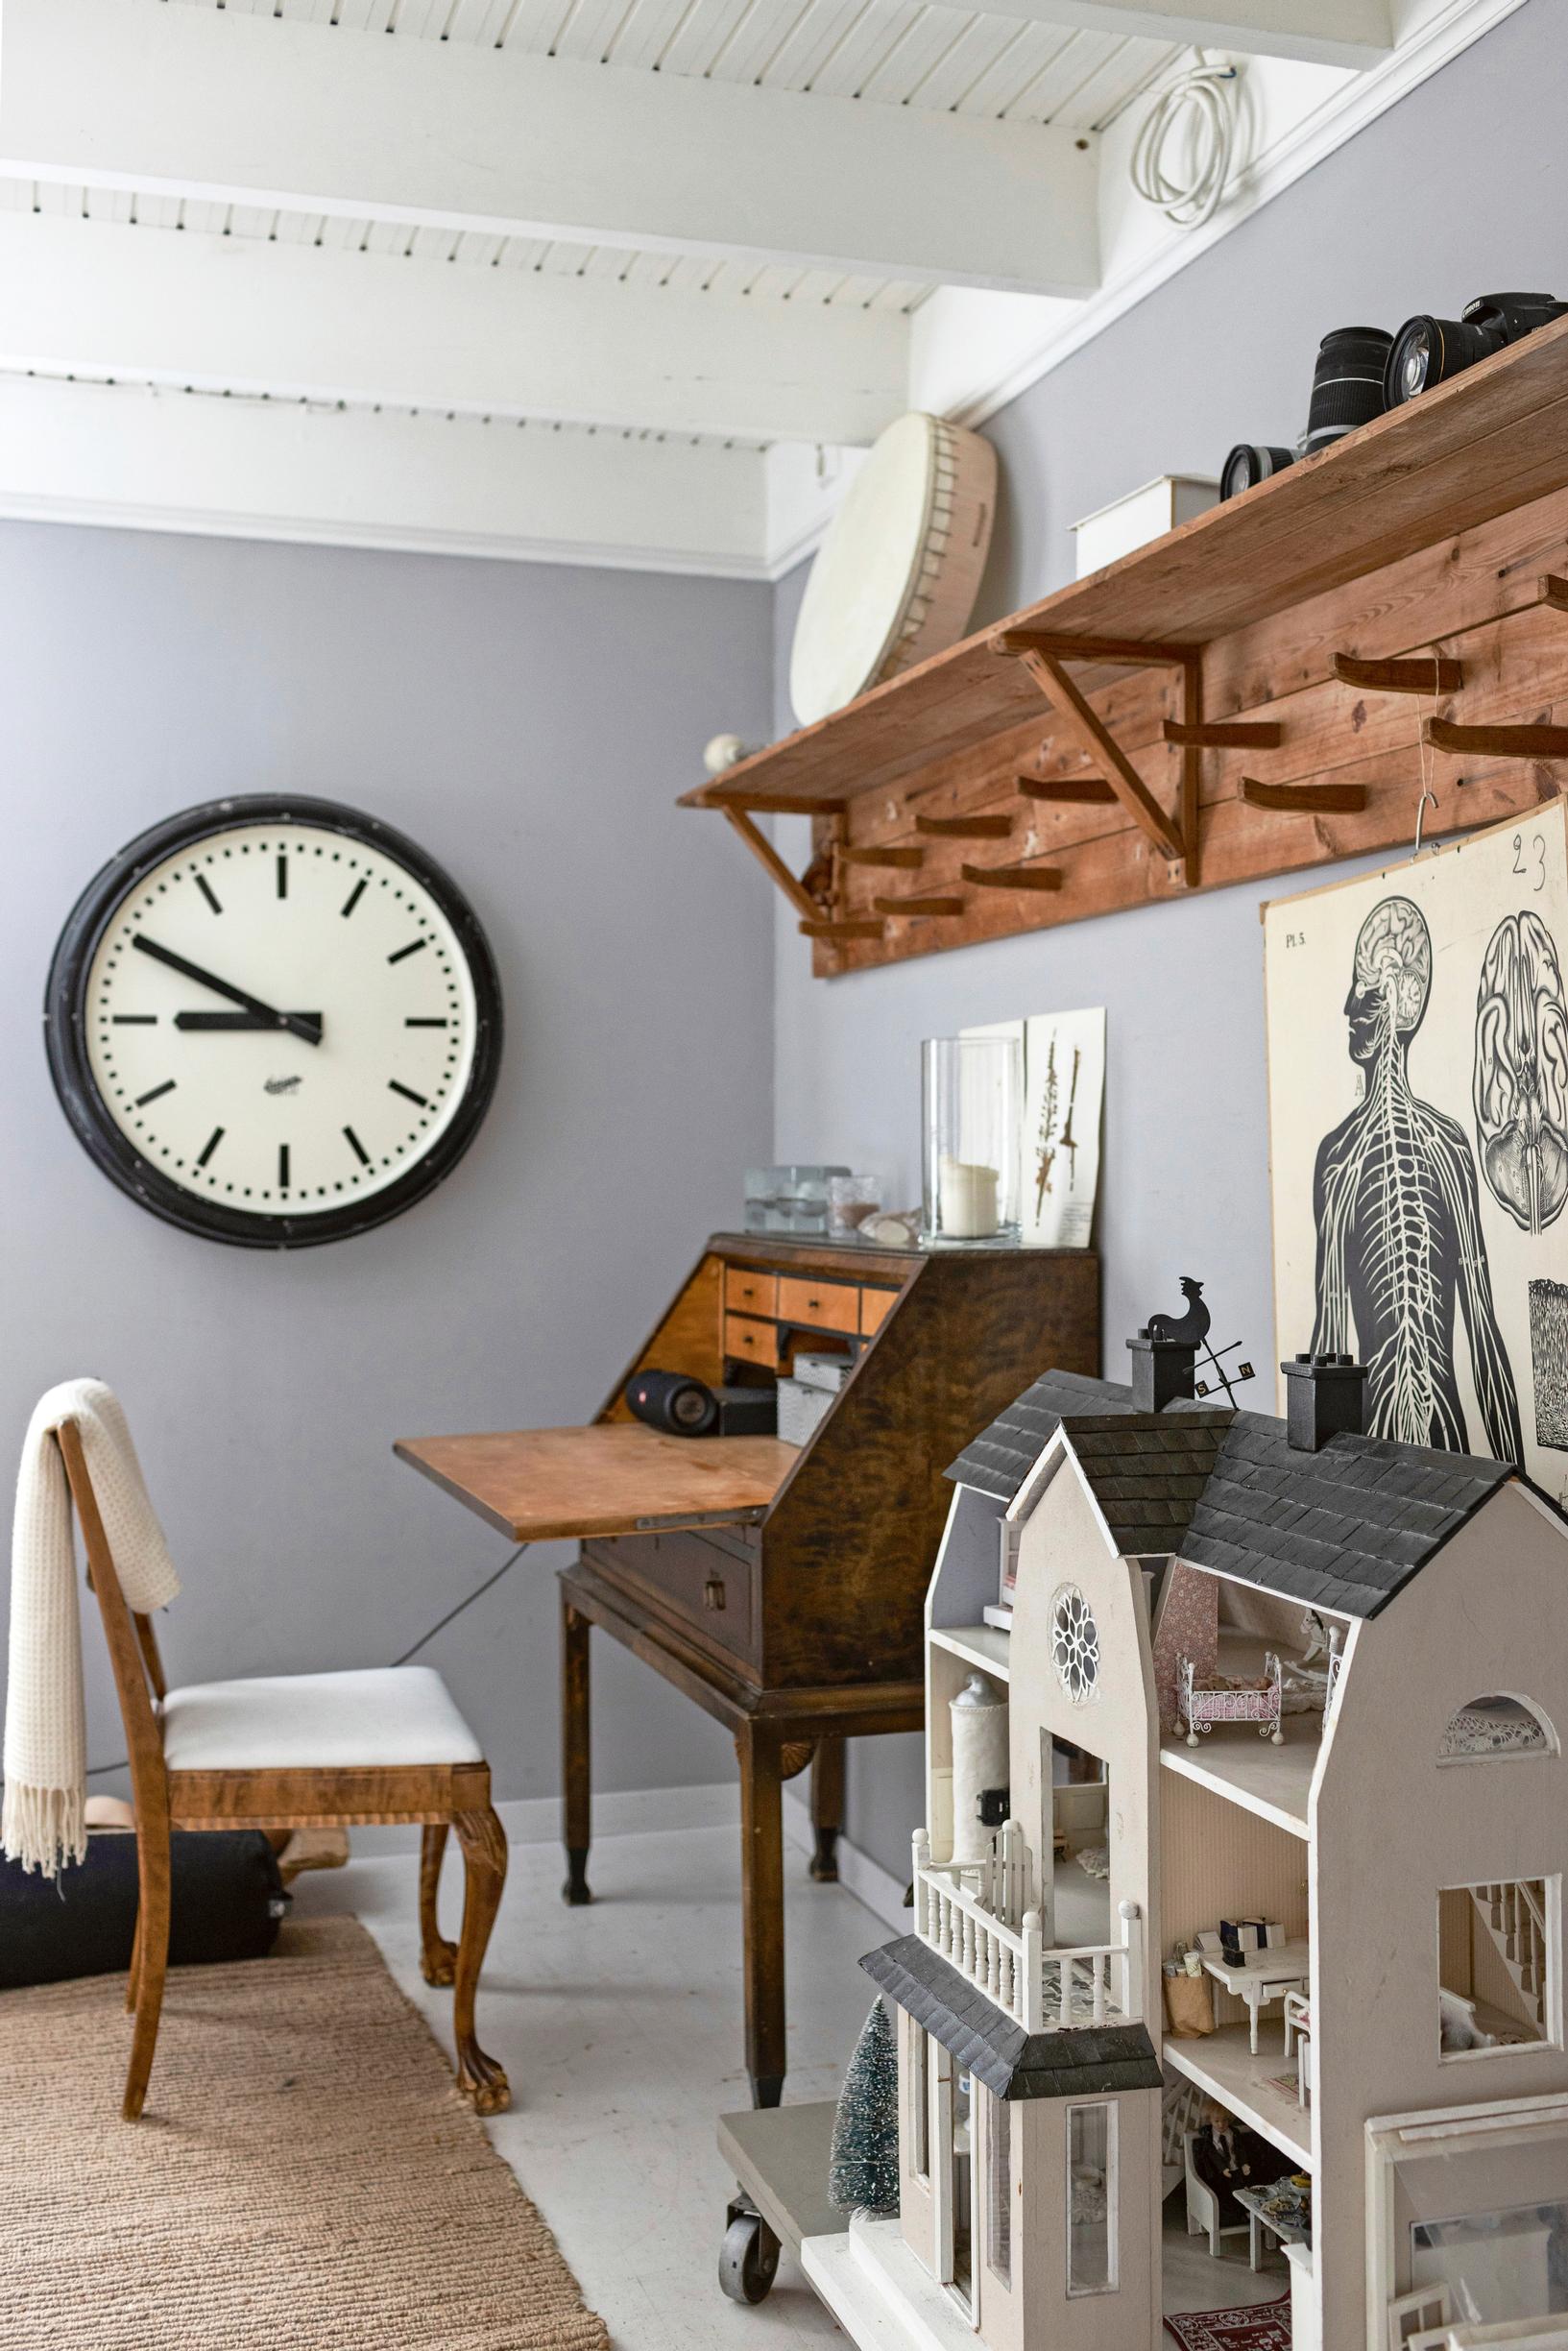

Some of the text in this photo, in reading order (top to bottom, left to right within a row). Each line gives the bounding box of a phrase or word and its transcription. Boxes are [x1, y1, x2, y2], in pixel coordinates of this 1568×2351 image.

[1512, 833, 1546, 892] 23
[1241, 1365, 1251, 1375] N
[1197, 1384, 1206, 1394] S
